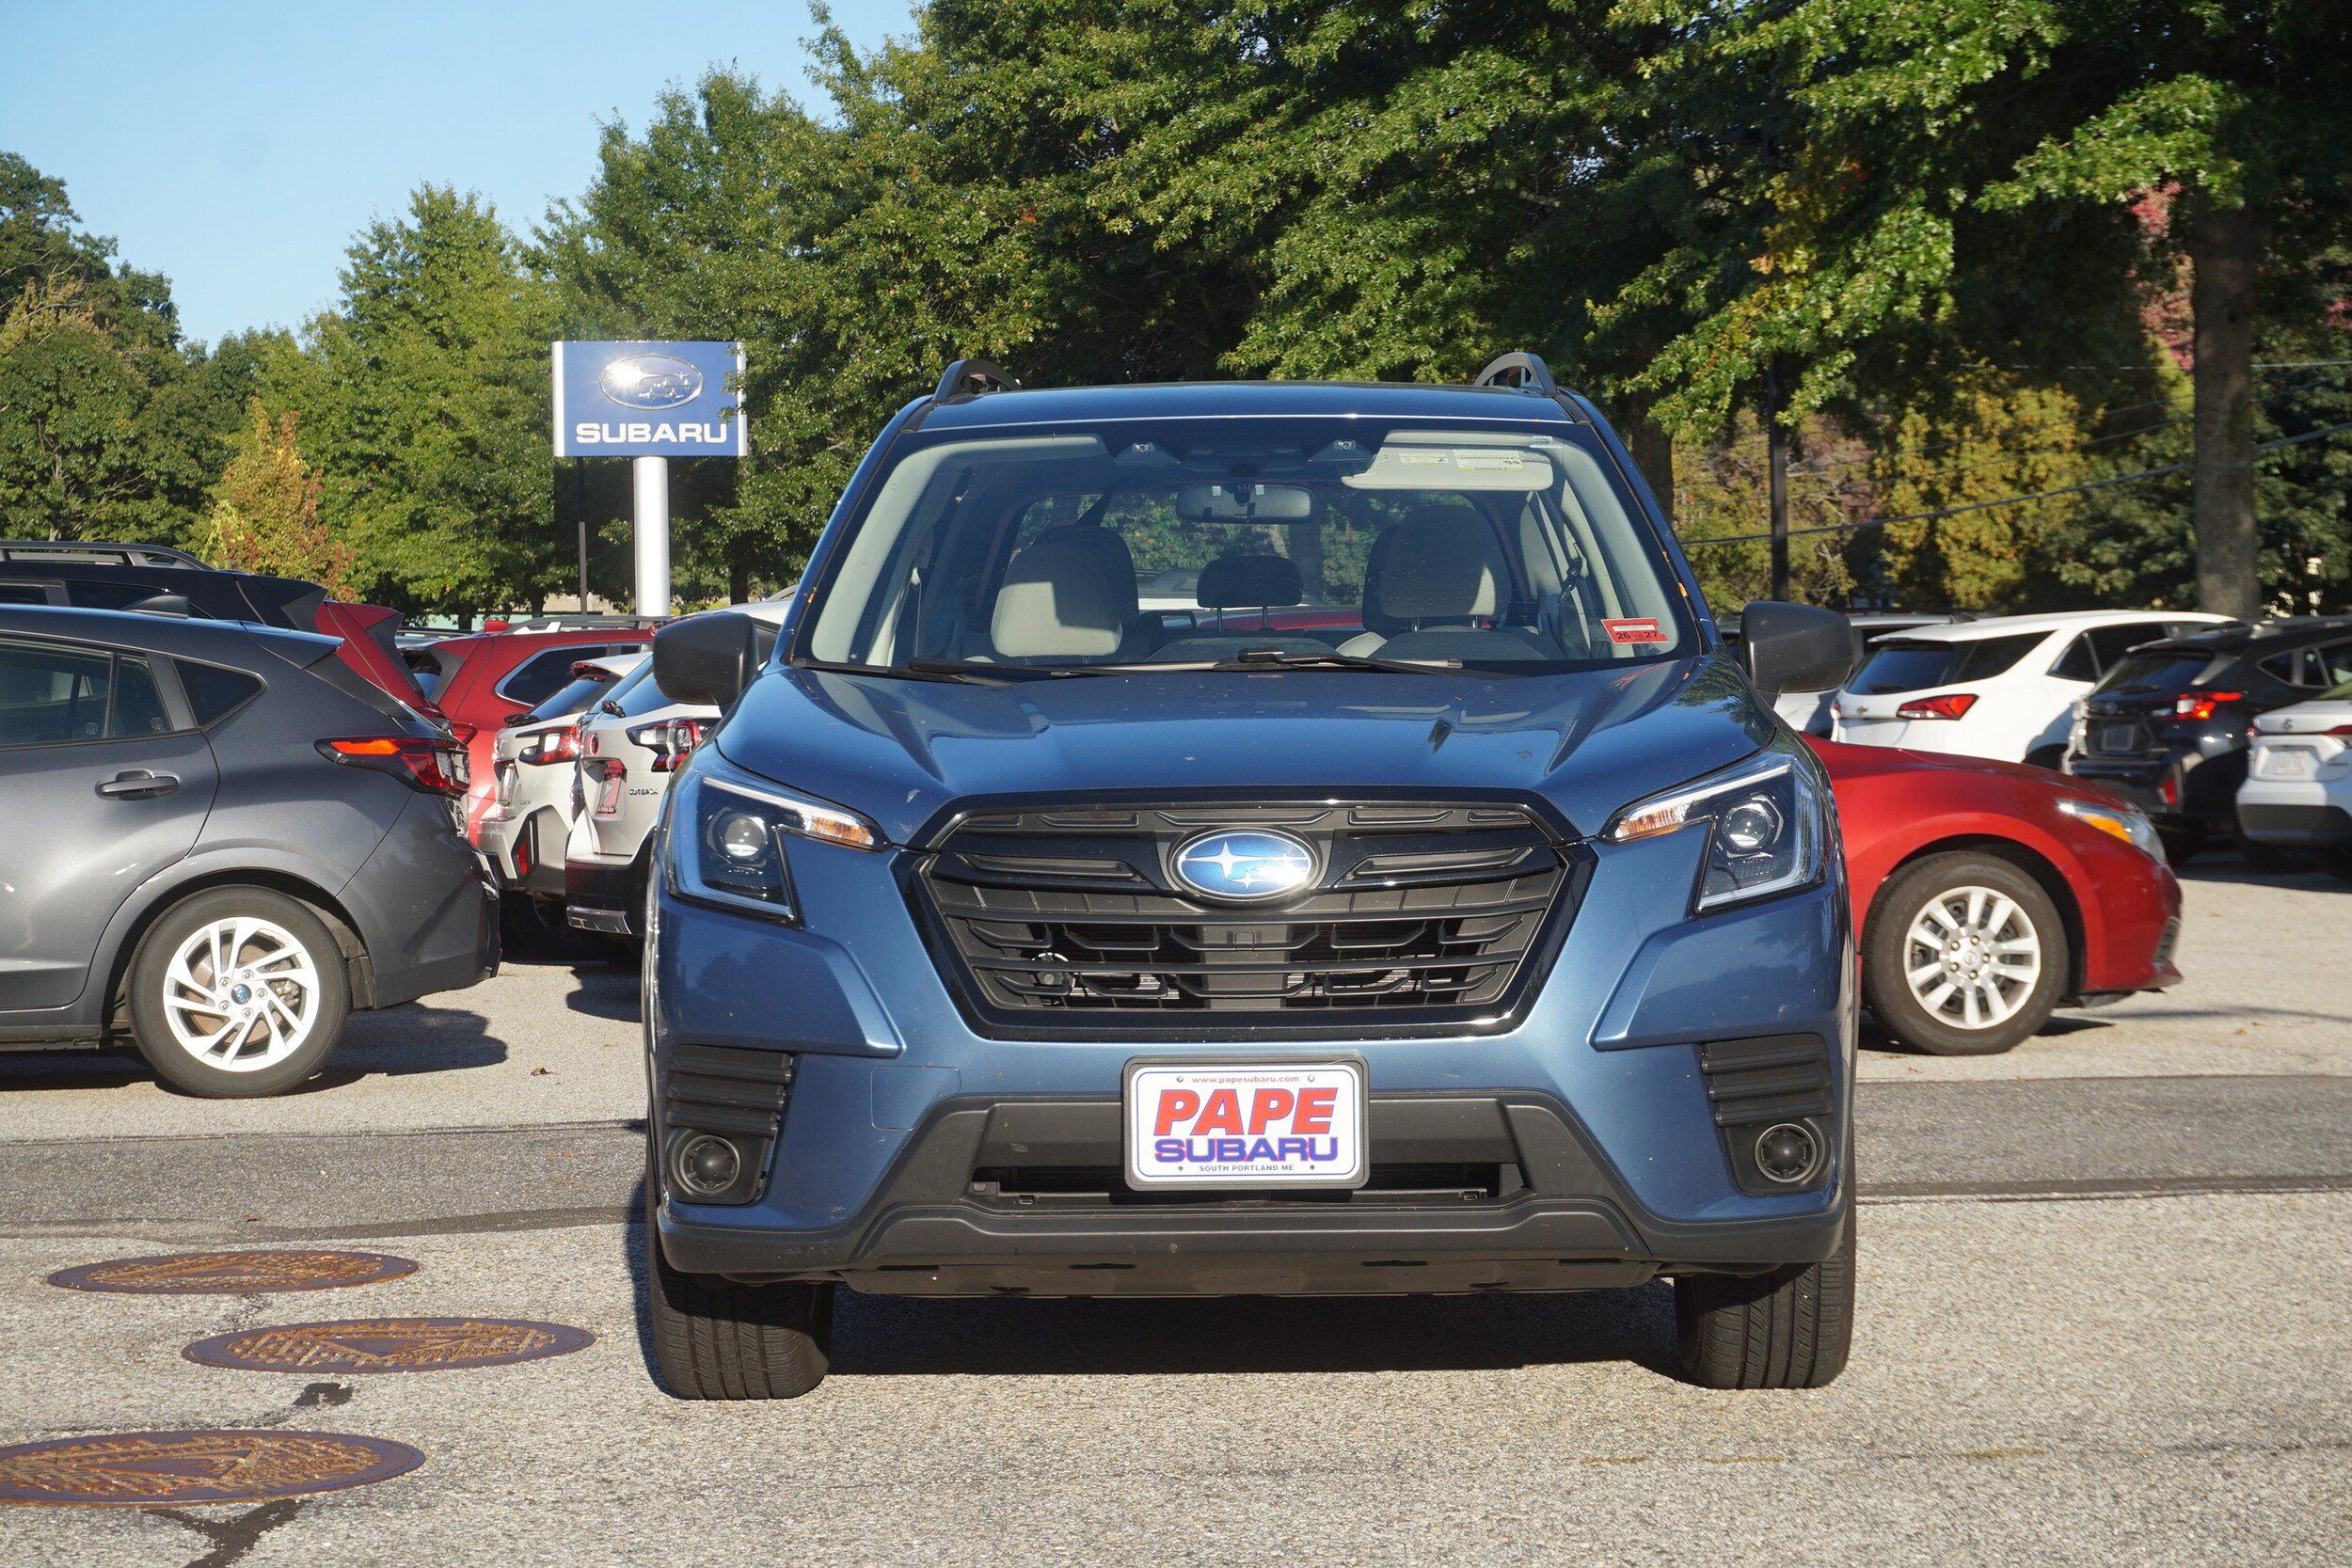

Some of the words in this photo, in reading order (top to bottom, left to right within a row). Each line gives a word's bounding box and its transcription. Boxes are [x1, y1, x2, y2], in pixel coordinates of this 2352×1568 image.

[576, 422, 727, 443] SUBARU
[1192, 1075, 1299, 1084] www.papesubaru.com
[1153, 1087, 1338, 1135] PAPE
[1154, 1137, 1338, 1163] SUBARU
